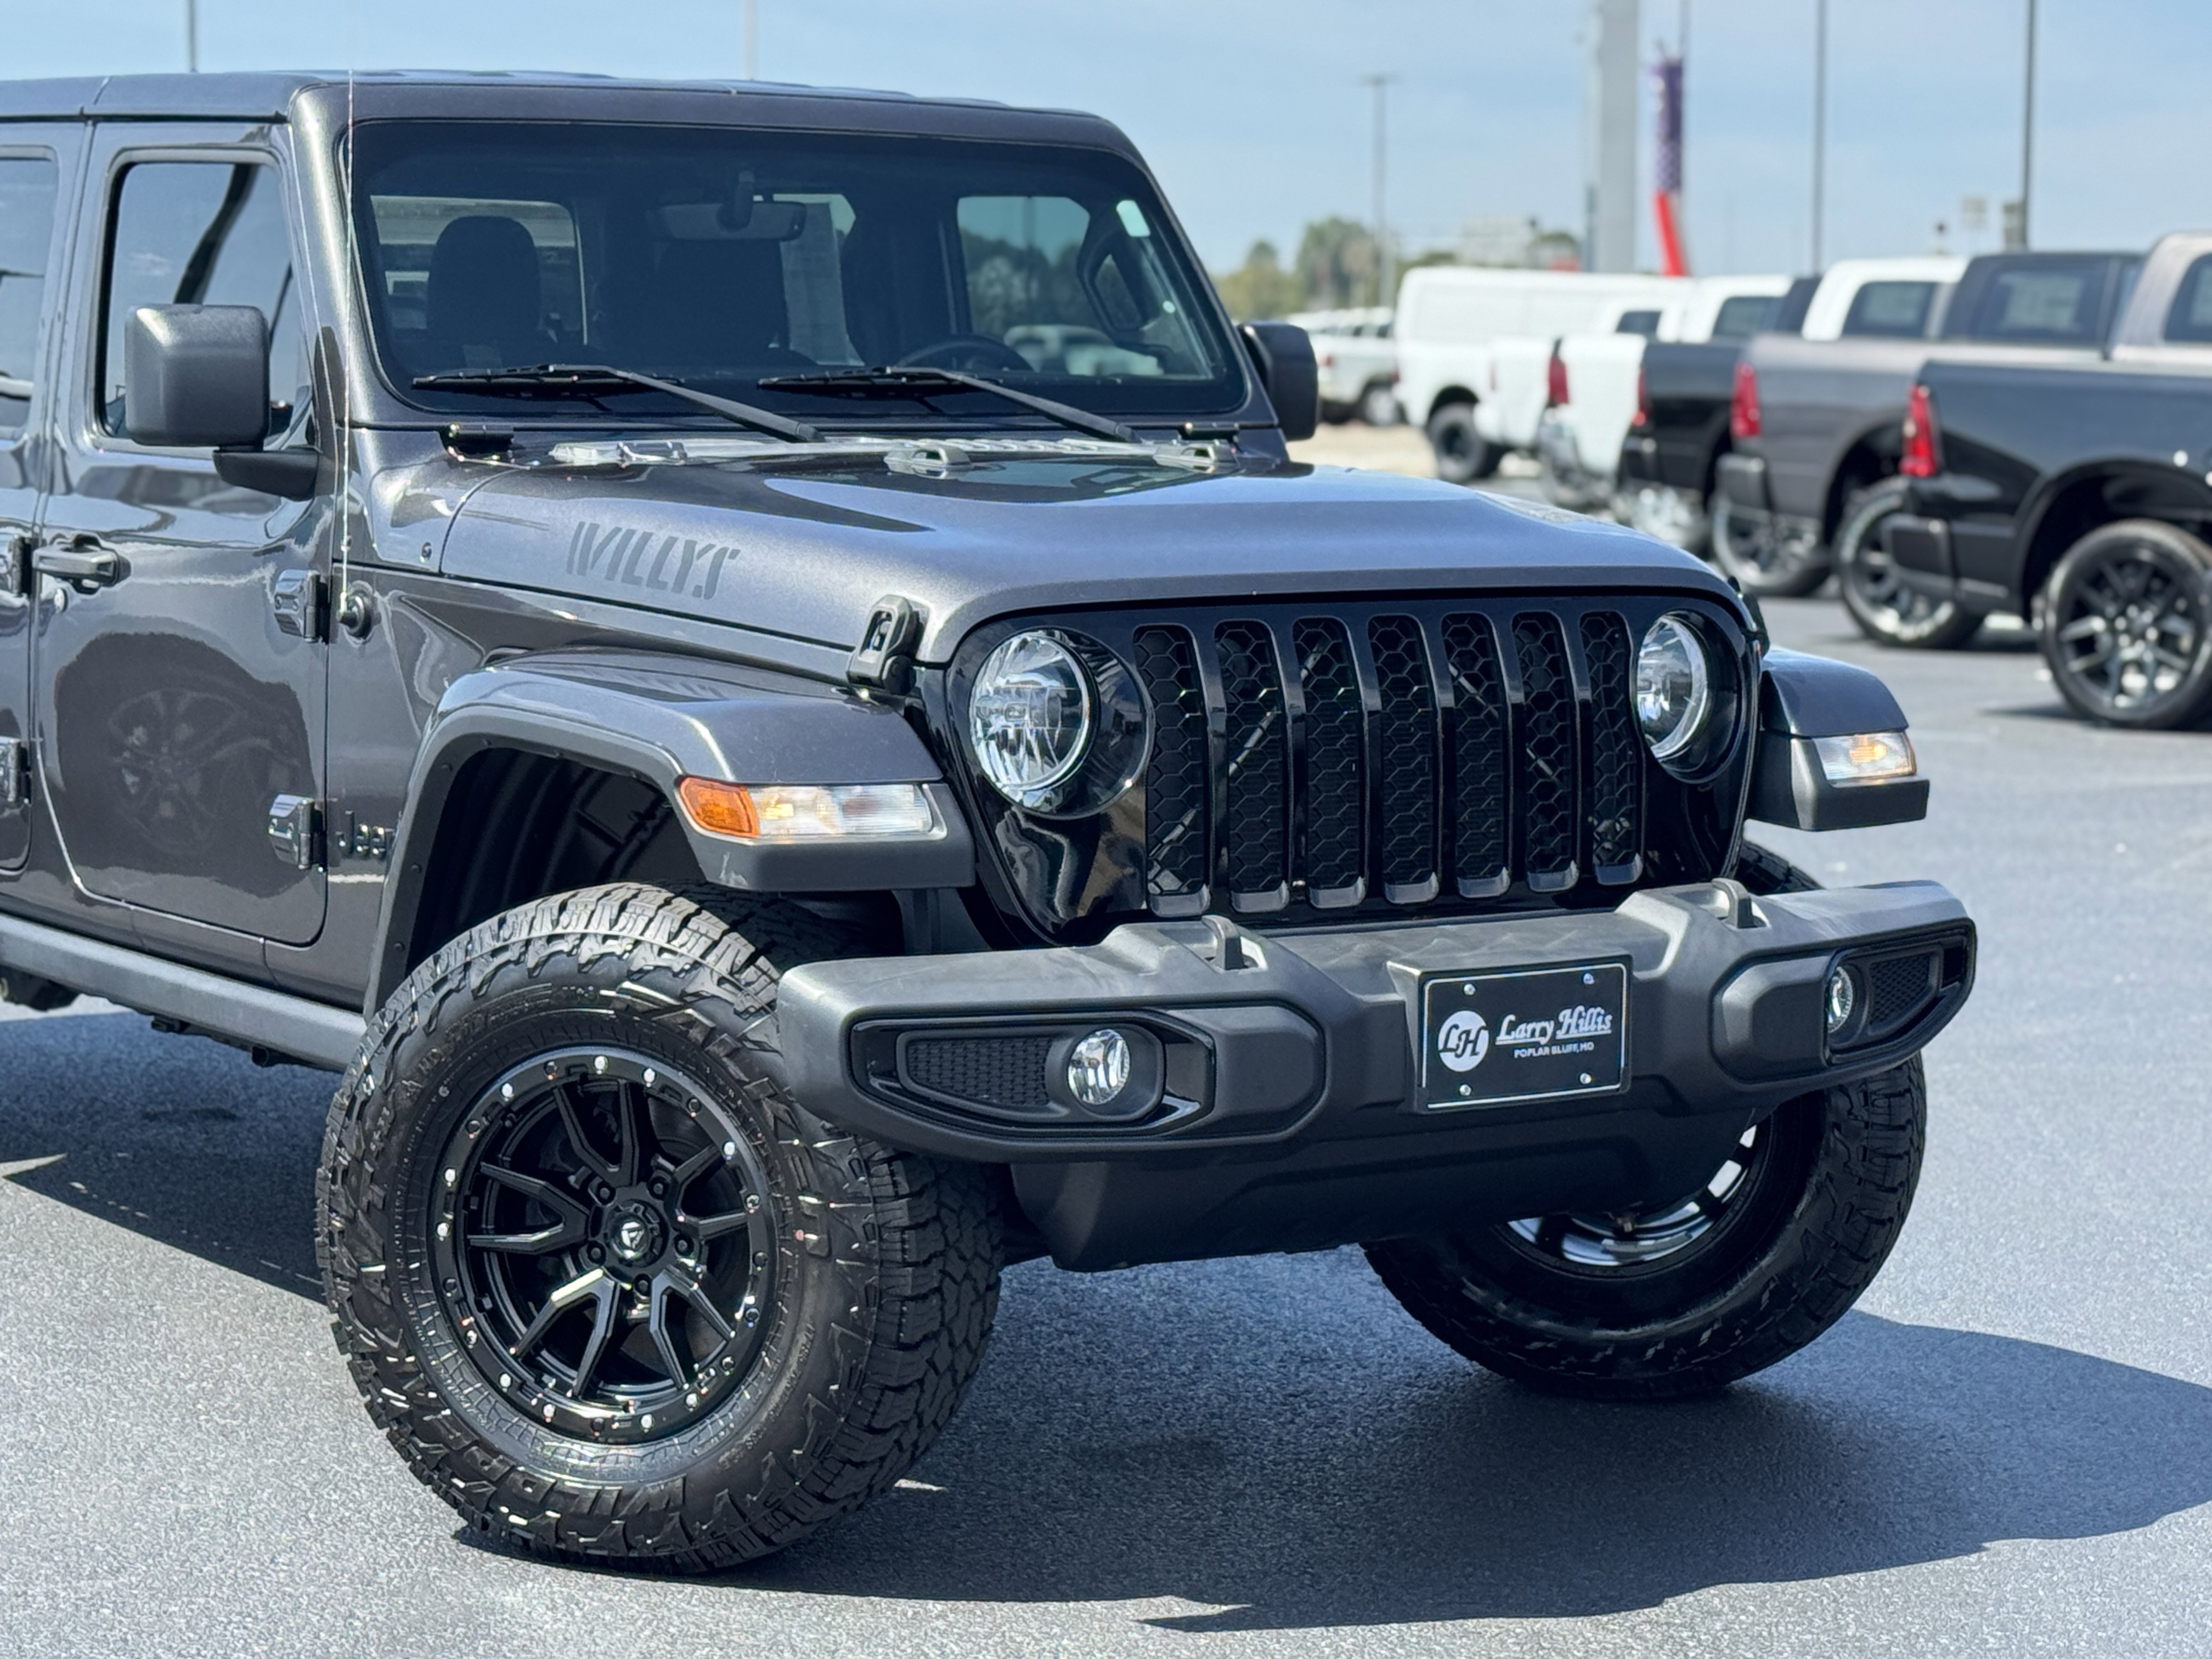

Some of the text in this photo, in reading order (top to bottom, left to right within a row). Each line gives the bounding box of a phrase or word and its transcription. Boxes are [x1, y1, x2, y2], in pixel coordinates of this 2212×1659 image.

[566, 521, 741, 600] WILLYS
[1496, 1005, 1613, 1045] Larry Hillis
[1514, 1046, 1550, 1058] POPLAR
